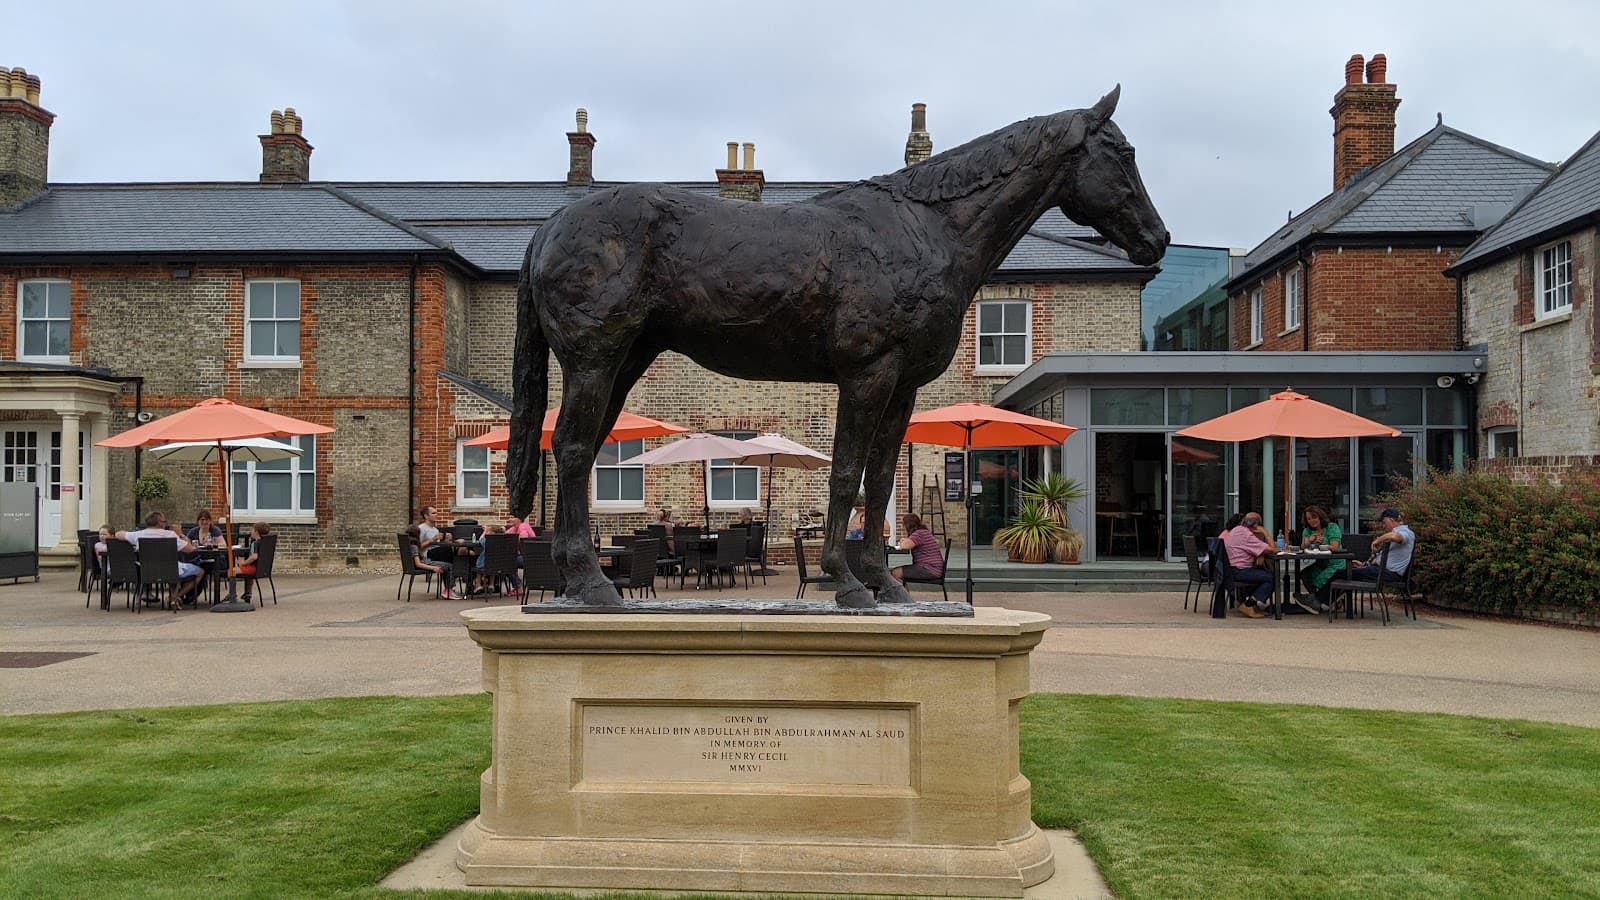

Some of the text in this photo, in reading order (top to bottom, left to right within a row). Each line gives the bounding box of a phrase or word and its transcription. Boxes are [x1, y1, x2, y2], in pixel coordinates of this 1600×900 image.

[725, 716, 769, 724] GIVEN BY
[589, 726, 905, 739] PRINCE KHALID BIN ABDULLAH BIN ABDULRAHMAN AL SAUD
[723, 740, 766, 748] MEMORY
[701, 752, 789, 761] SIR HENRY CECIL
[729, 764, 761, 772] MMXVI
